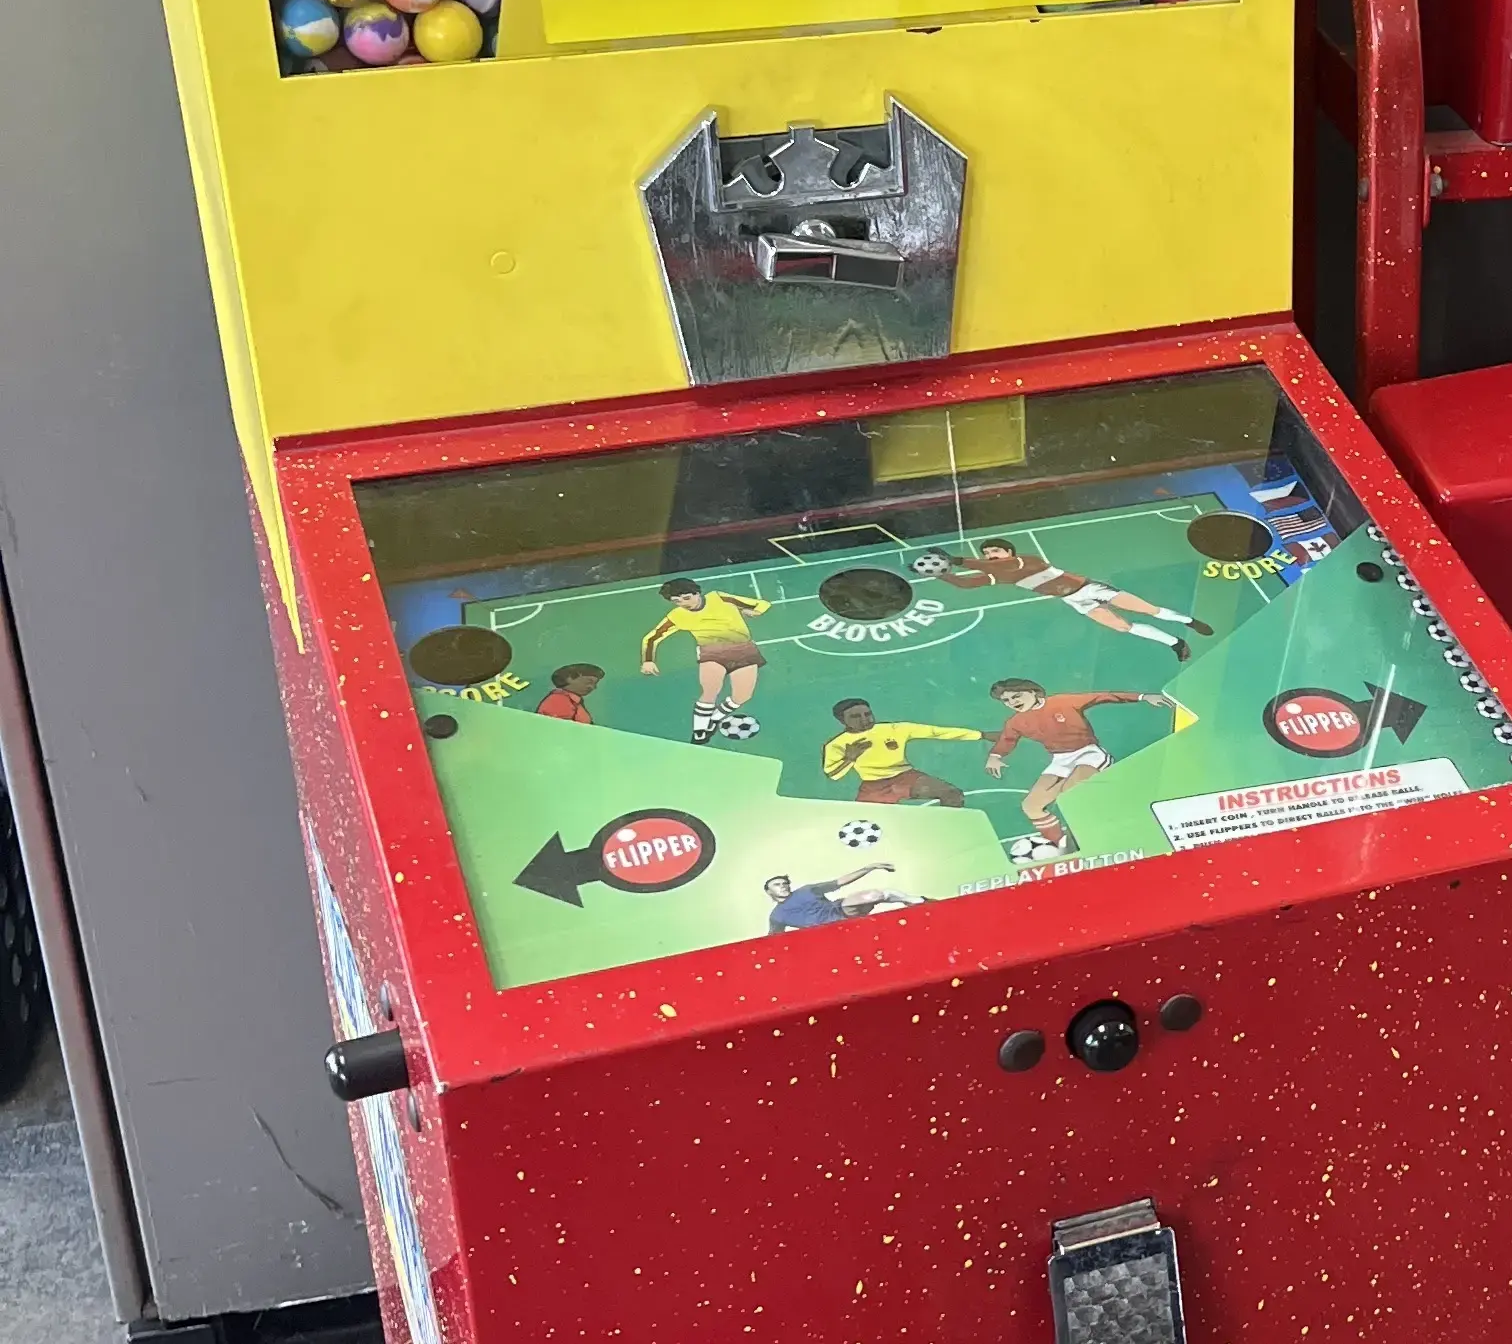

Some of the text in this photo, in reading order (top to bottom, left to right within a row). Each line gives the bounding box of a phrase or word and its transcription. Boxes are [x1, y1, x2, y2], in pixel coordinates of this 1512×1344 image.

[1202, 548, 1298, 581] SCORE
[807, 597, 945, 643] BLOCKED
[421, 672, 531, 703] ORE
[1278, 709, 1358, 739] FLIPPER
[1217, 768, 1401, 812] INSTRUCTIONS
[1181, 817, 1218, 829] INSERT
[1221, 812, 1248, 823] COIN
[1287, 799, 1328, 814] HANDLE
[1331, 797, 1345, 805] TO
[1187, 830, 1208, 840] USE
[1210, 822, 1259, 836] FLIPPERS
[1260, 819, 1275, 828] TO
[1277, 813, 1313, 826] DIRECT
[604, 832, 699, 872] FLIPPER
[959, 848, 1145, 897] REPLAY BUTTON
